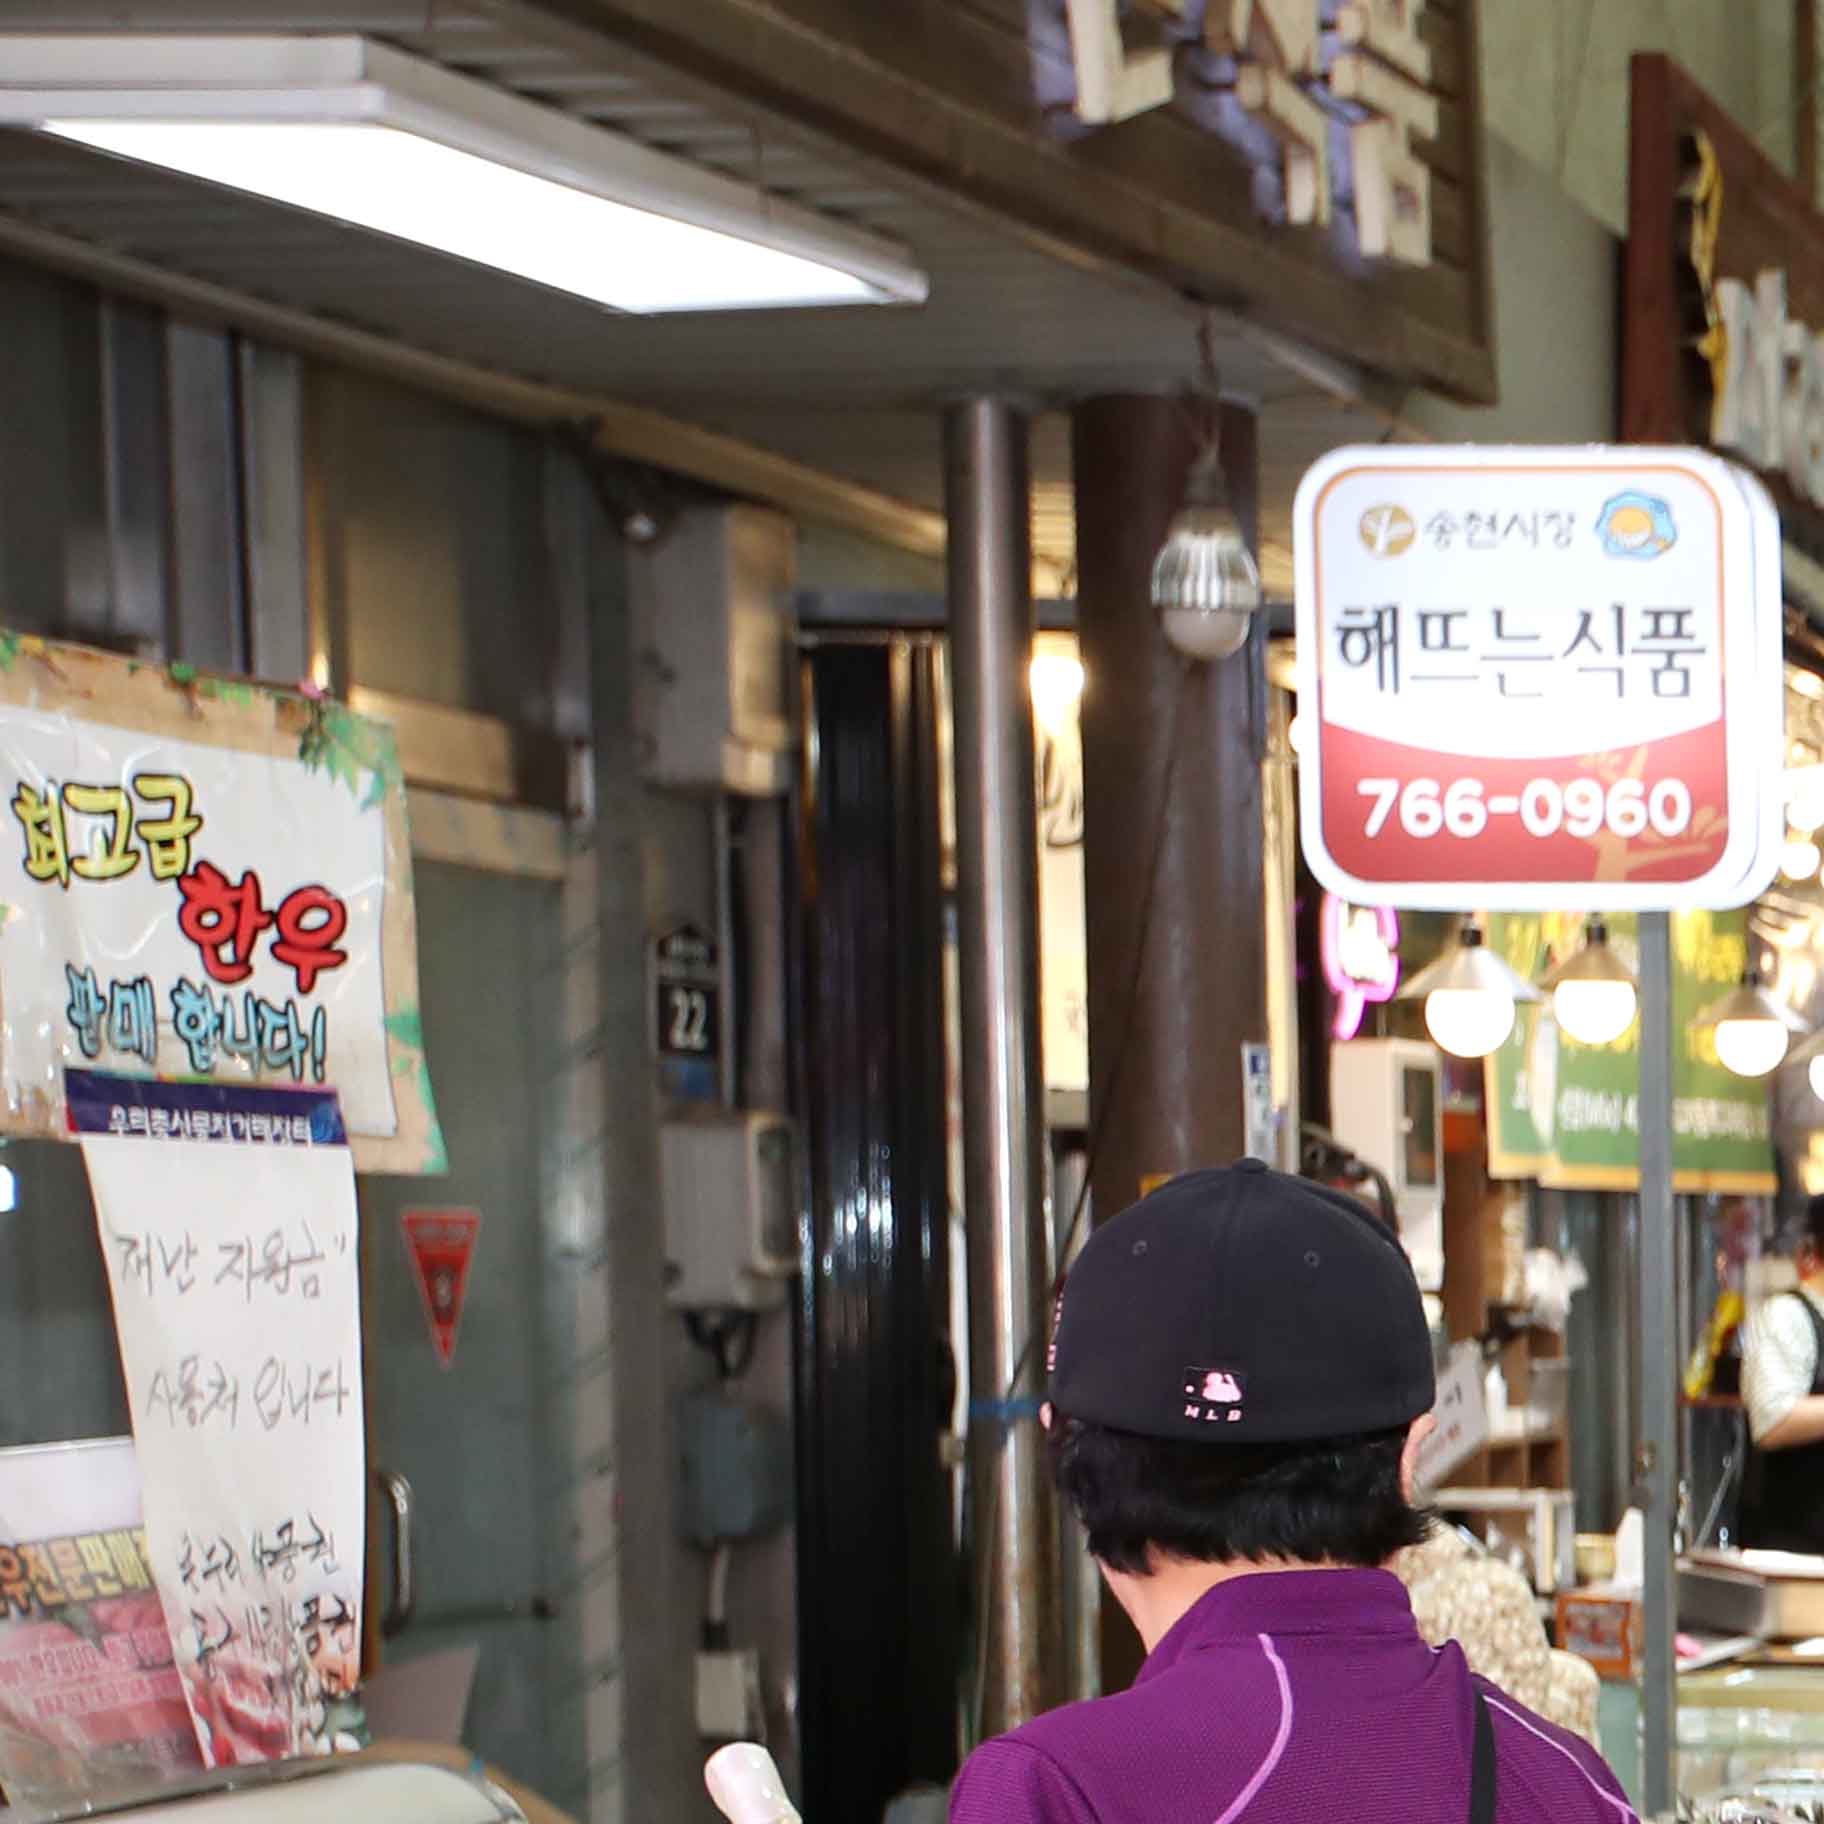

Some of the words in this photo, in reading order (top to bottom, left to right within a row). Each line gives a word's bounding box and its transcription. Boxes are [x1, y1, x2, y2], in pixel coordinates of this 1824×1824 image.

[1424, 510, 1576, 551] 송현시장
[1333, 602, 1708, 699] 해뜨는식품
[11, 772, 204, 889] 최고급
[1356, 777, 1692, 839] 766-0960
[177, 860, 348, 995] 한우
[64, 962, 158, 1066] 판매
[115, 1230, 198, 1297] 재난
[253, 1354, 351, 1431] 입니다
[1184, 1403, 1242, 1423] MLB
[0, 1526, 158, 1617] 우전문판매
